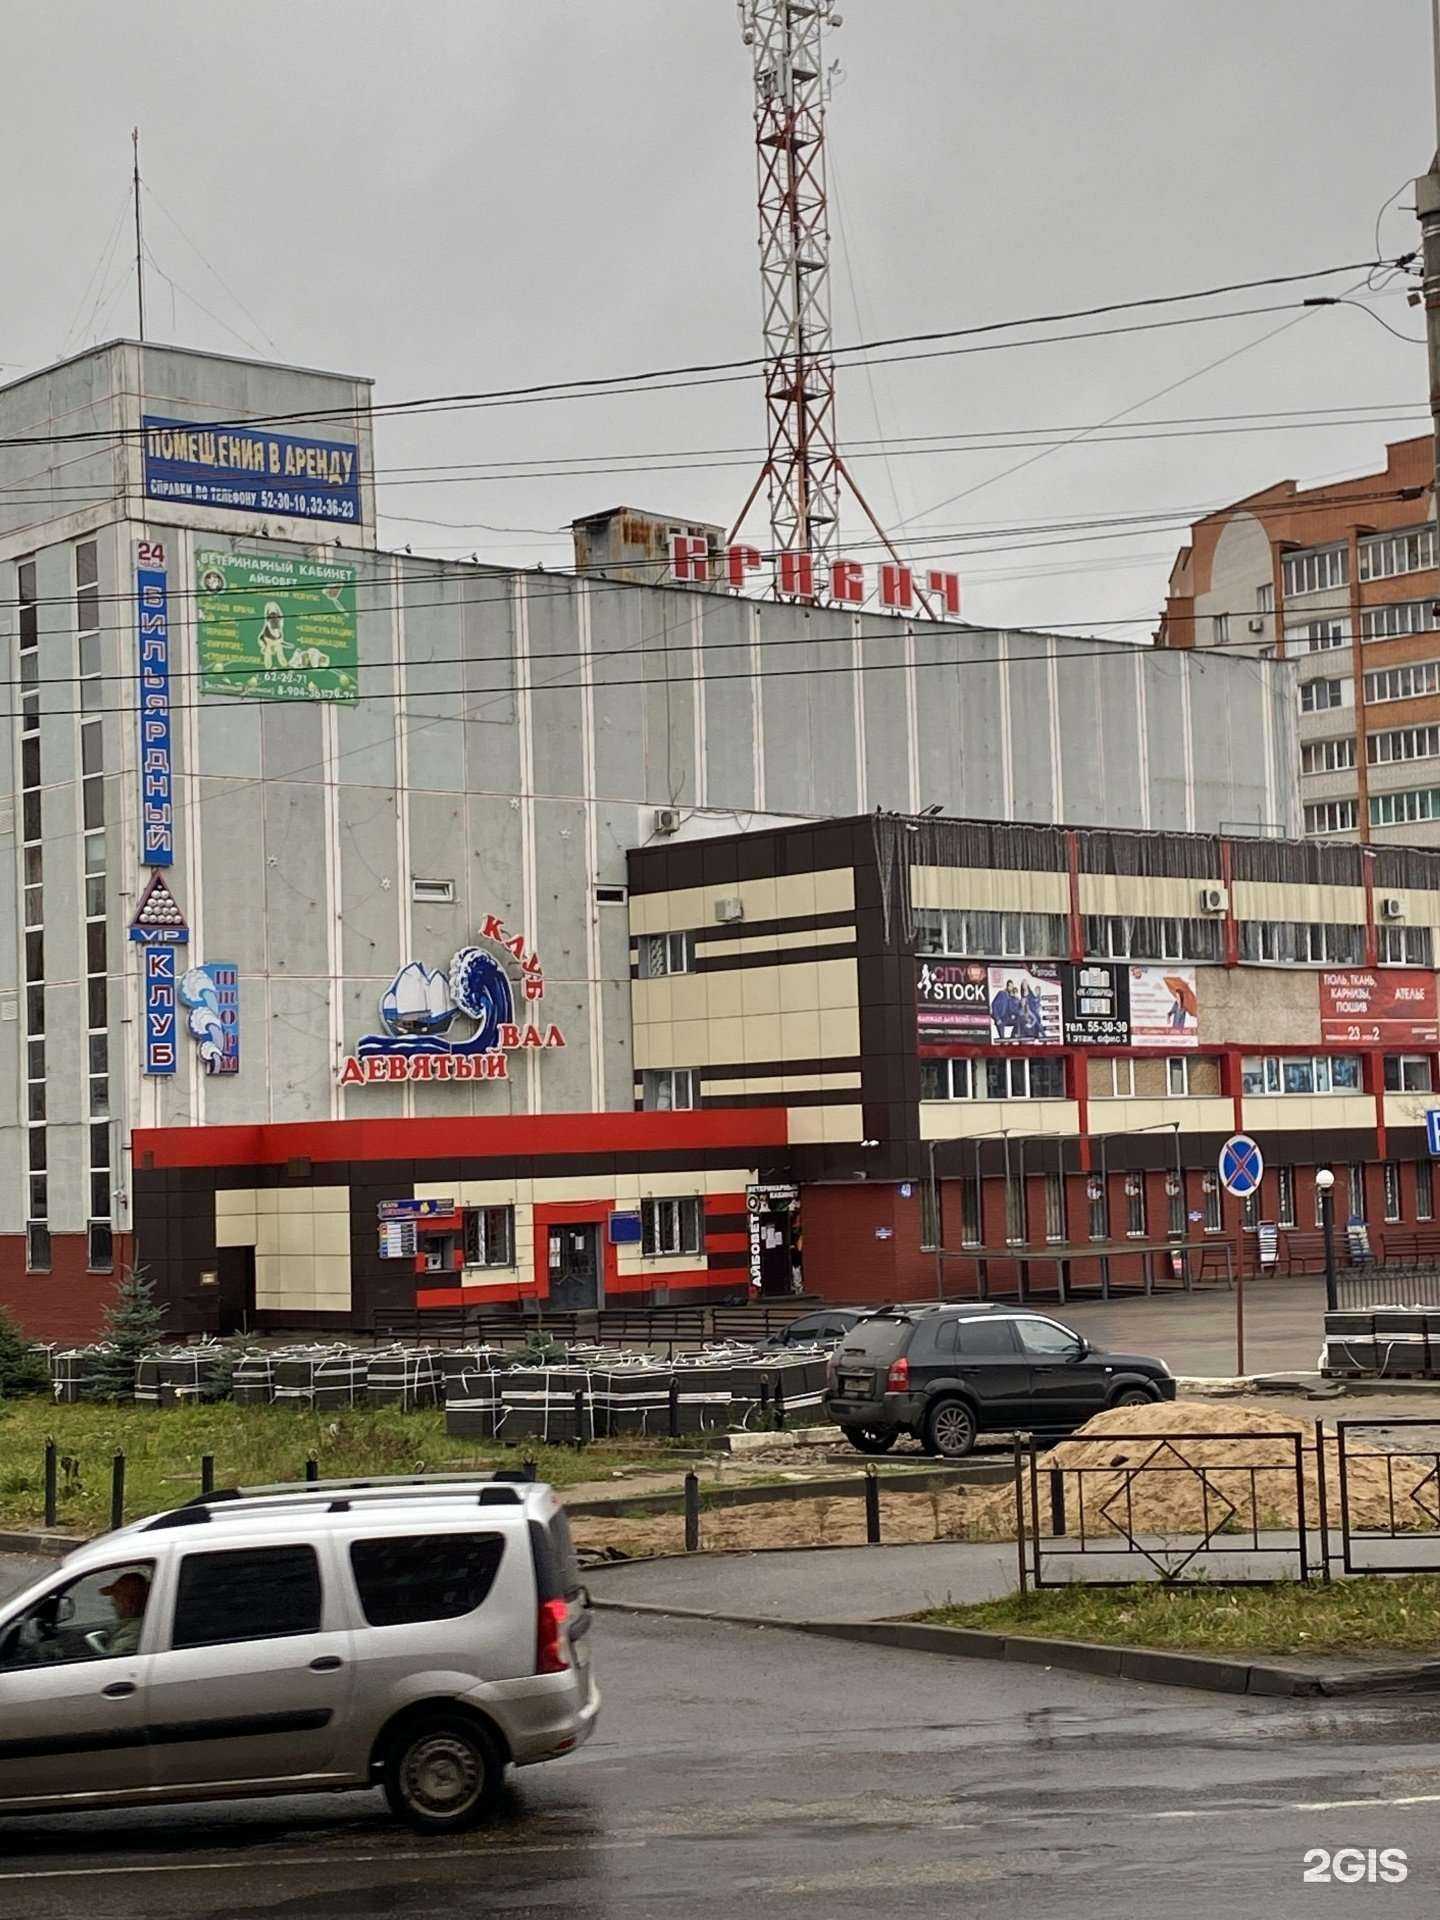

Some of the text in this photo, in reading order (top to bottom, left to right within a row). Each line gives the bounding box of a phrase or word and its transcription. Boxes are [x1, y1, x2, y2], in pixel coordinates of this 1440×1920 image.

[148, 426, 353, 485] ПОМЕЩЕНИЯ В АРЕНДУ
[138, 542, 163, 562] 24
[200, 552, 353, 581] ВЕТЕРИНАРНЫЙ КАБИНЕТ
[141, 585, 172, 852] БИЛЬЯРДНЫЙ
[481, 913, 544, 1000] КЛУБ
[934, 966, 967, 982] CITY
[933, 983, 986, 1000] STOCK
[1394, 987, 1425, 1000] АТЕЛЬЕ
[150, 954, 174, 1066] КЛУБ
[1336, 1001, 1367, 1013] ПОШИВ
[1347, 1026, 1361, 1041] 23
[340, 1024, 566, 1085] ДЕВЯТЫЙ ВАЛ
